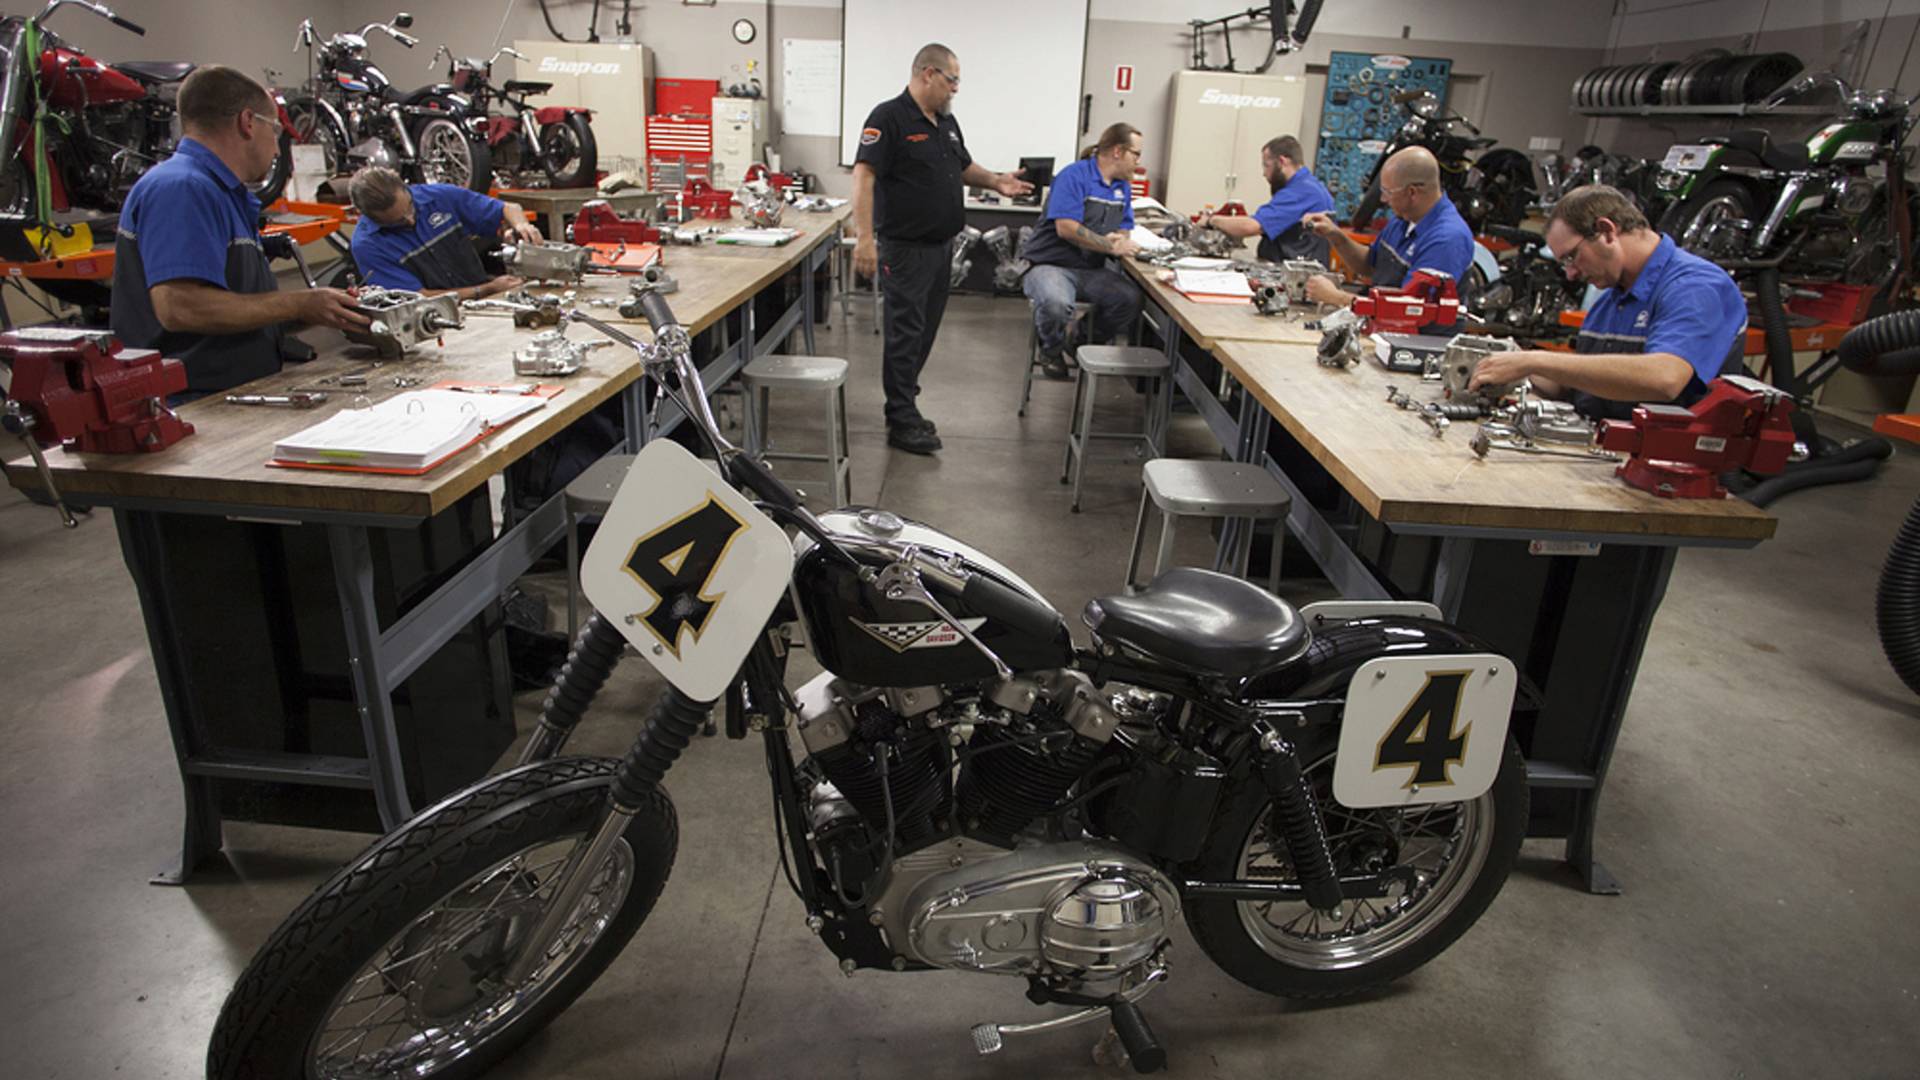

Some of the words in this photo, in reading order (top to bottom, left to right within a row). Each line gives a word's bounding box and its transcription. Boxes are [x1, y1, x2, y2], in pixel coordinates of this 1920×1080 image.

[538, 56, 621, 76] Snap-on
[1198, 88, 1282, 109] Snap-on
[619, 488, 752, 662] 4
[1372, 669, 1474, 789] 4
